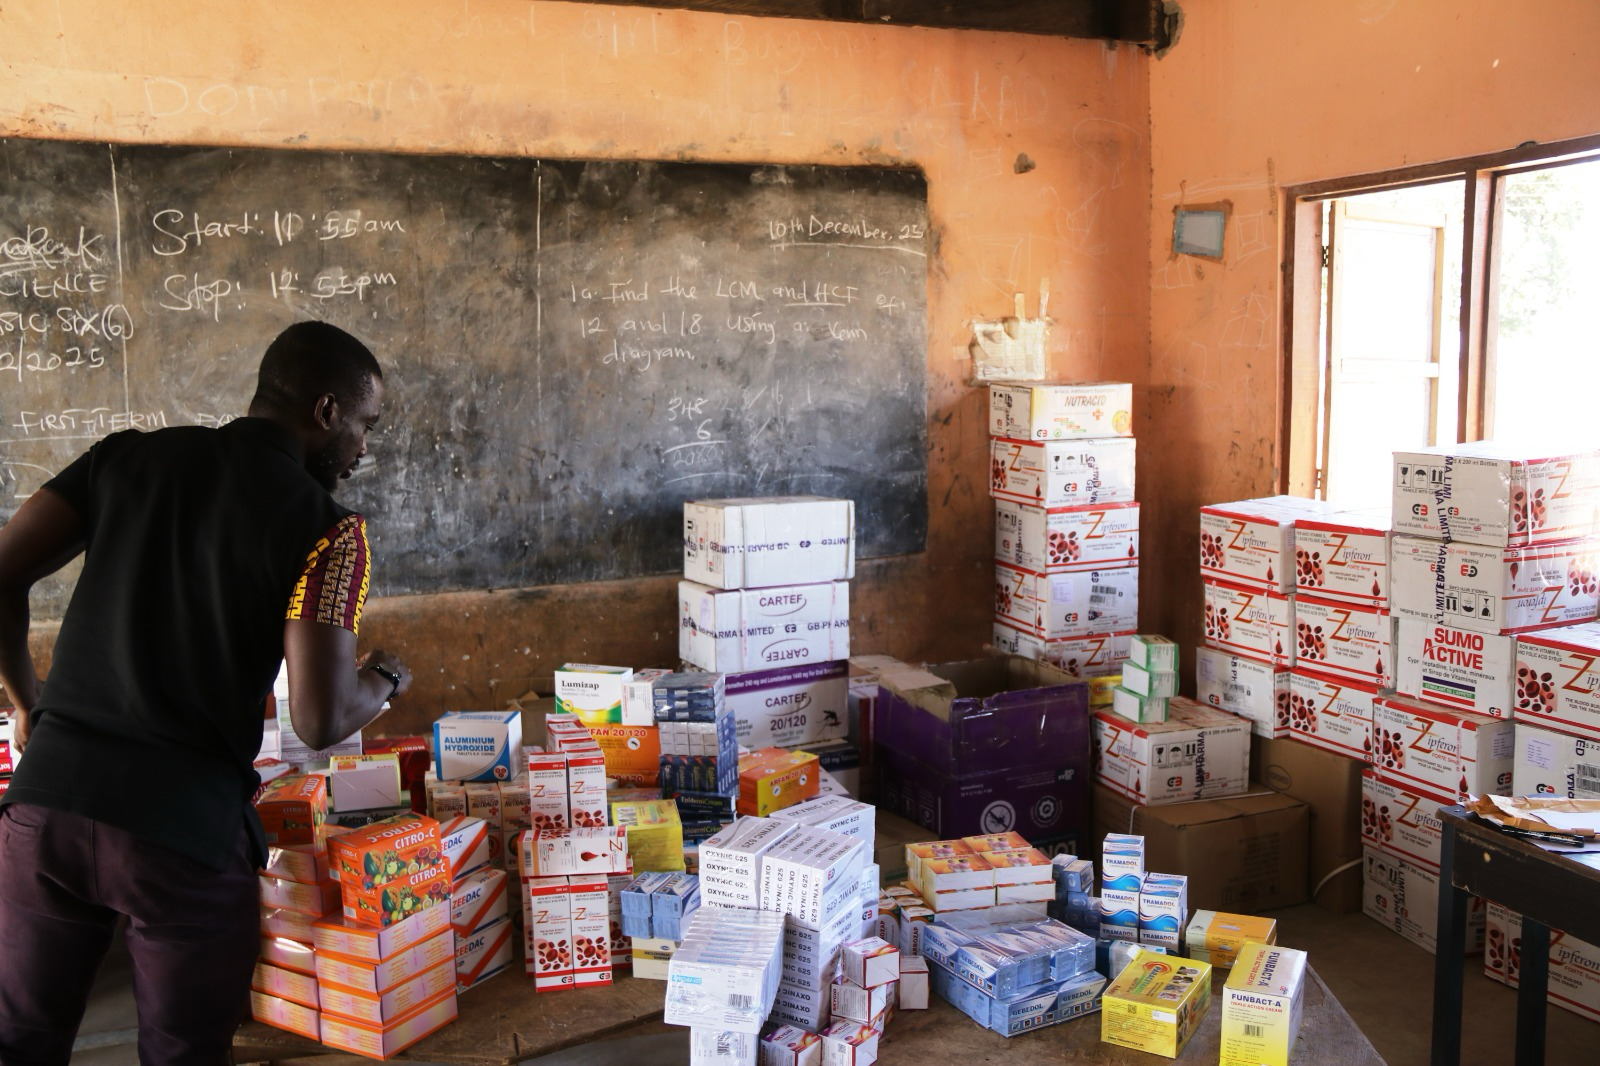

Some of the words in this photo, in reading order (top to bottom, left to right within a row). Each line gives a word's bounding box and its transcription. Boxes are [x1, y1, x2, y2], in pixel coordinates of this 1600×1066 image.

[660, 276, 698, 301] the
[716, 278, 764, 301] LCM
[773, 278, 807, 301] and
[581, 317, 607, 339] 12
[623, 312, 667, 335] and
[681, 311, 703, 338] 18
[1064, 395, 1107, 408] NUTRACID
[1227, 520, 1267, 551] Zipferon
[1324, 533, 1372, 566] Zipferon
[758, 594, 804, 608] CARTEF
[1327, 608, 1375, 642] Zipferon
[1434, 627, 1484, 652] SUMO
[765, 647, 810, 662] CARTEF
[1422, 638, 1483, 670] ACTIVE
[1428, 669, 1443, 678] Sirop
[1451, 673, 1477, 684] Vitamines
[1469, 670, 1496, 680] mineraux
[561, 680, 600, 690] Lumizap
[765, 692, 808, 708] CARTEF
[1319, 683, 1363, 717] Zipferon
[770, 714, 807, 732] 20/120
[444, 736, 495, 745] ALUMINIUM
[613, 729, 647, 738] 20/120
[444, 744, 496, 752] HYDROXIDE
[471, 800, 500, 809] NUTRACID
[394, 827, 435, 850] CITRO-C
[440, 834, 463, 850] EEDAC
[1105, 858, 1138, 867] TRAMADOL
[409, 862, 447, 886] CITRO-C
[735, 868, 749, 876] 625
[452, 888, 481, 910] ZEEDAC
[838, 881, 860, 904] OXYNIC
[1103, 892, 1136, 902] TRAMADOL
[799, 889, 808, 920] OXYNIC
[1142, 898, 1176, 908] TRAMADOL
[810, 909, 818, 923] 625
[798, 931, 812, 941] 625
[1102, 928, 1135, 937] TRAMADOL
[1142, 933, 1176, 942] TRAMADOL
[798, 943, 812, 952] 625
[798, 955, 812, 964] 625
[960, 955, 985, 973] GEBEDOL
[797, 966, 812, 976] 625
[1258, 951, 1280, 987] FUNBACT-A
[1564, 965, 1584, 977] FORTE
[797, 978, 811, 987] 625
[782, 988, 811, 1001] OXYNIC
[1062, 988, 1092, 1002] GEBEDOL
[1231, 993, 1281, 1007] FUNBACT-A
[782, 999, 811, 1013] OXYNIC
[1012, 1003, 1044, 1016] GEBEDOL
[781, 1011, 810, 1025] OXYNIC
